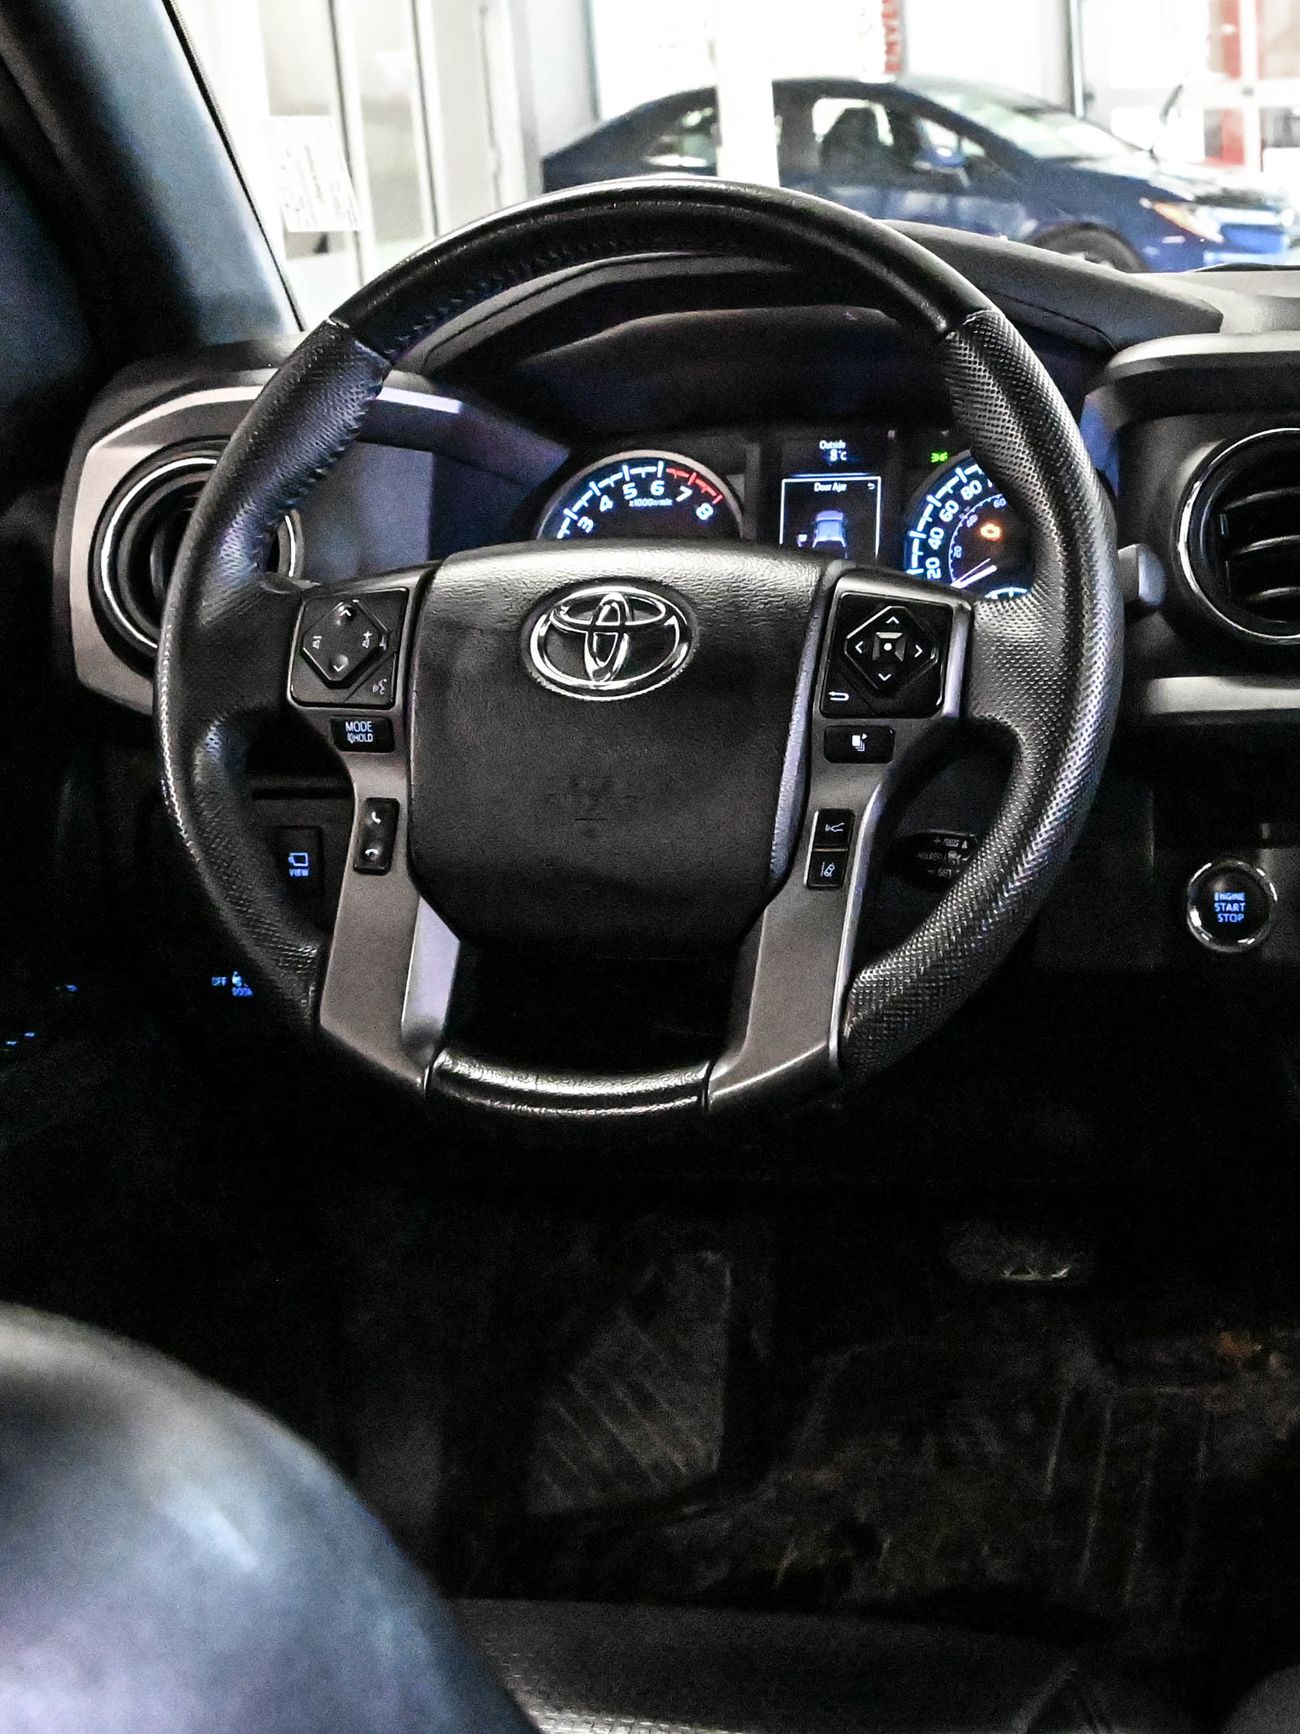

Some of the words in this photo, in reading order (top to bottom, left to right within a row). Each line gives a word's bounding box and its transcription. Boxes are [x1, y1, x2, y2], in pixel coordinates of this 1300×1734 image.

[622, 483, 638, 500] 5
[650, 480, 665, 496] 6
[676, 485, 693, 502] 7
[814, 482, 832, 492] Door
[960, 480, 983, 500] 80
[600, 494, 614, 513] 4
[696, 502, 714, 521] 8
[939, 500, 960, 523] 60
[577, 516, 595, 534] 3
[927, 527, 945, 550] 40
[925, 557, 942, 580] 20
[345, 720, 373, 732] MODE
[1214, 902, 1246, 912] START
[1217, 913, 1245, 923] STOP
